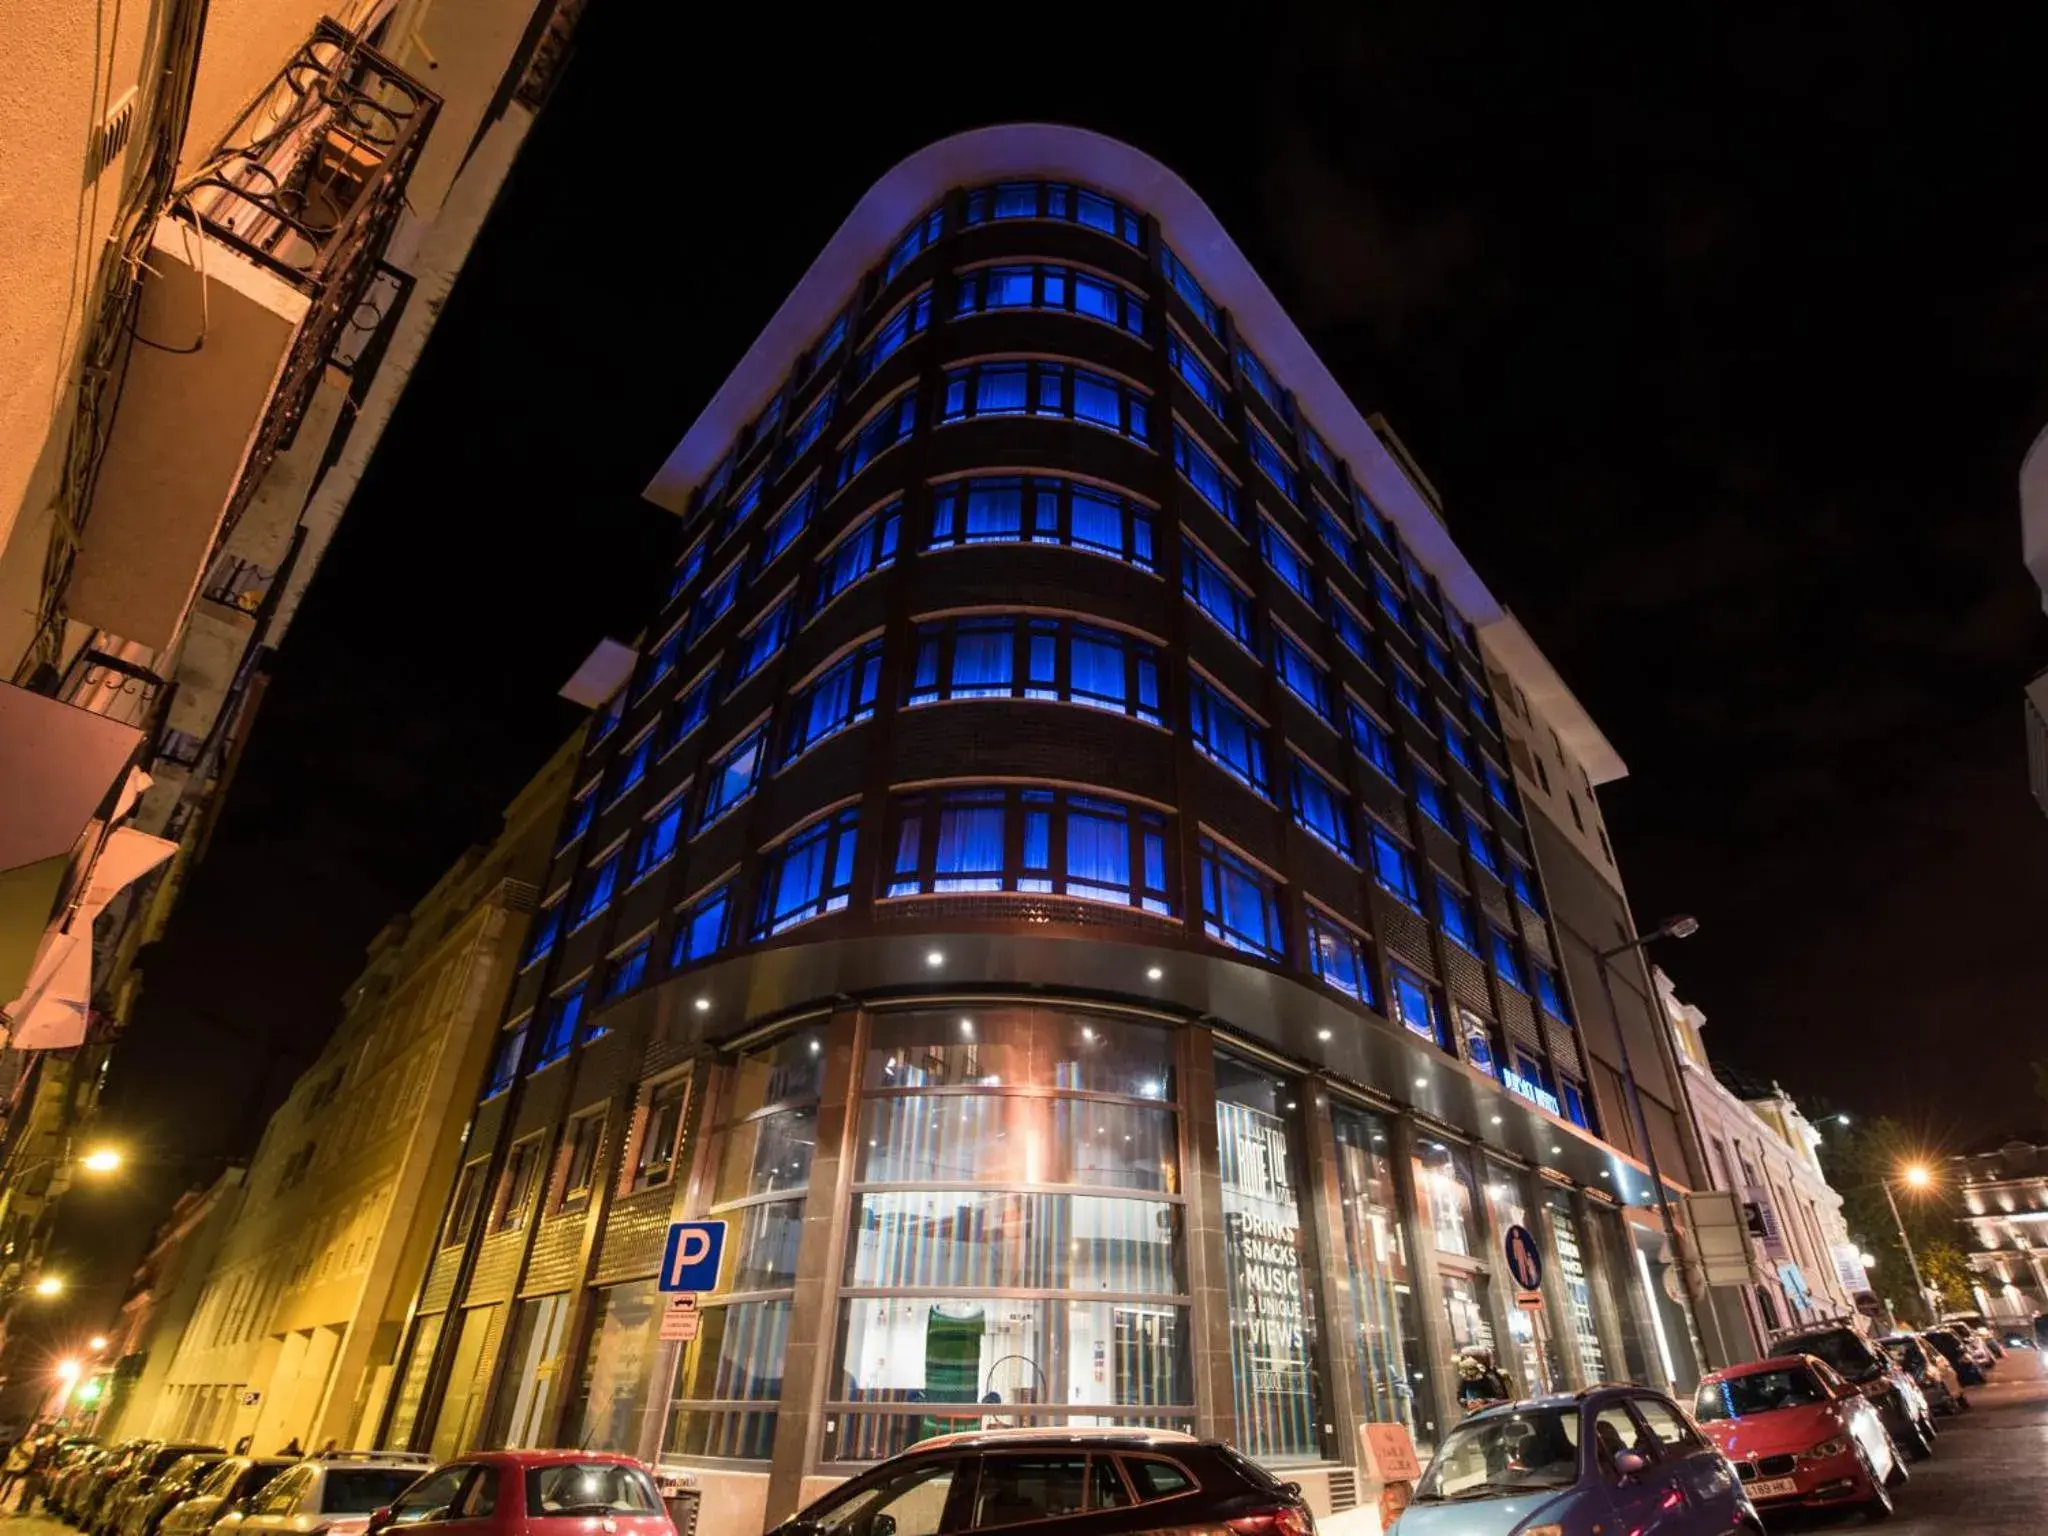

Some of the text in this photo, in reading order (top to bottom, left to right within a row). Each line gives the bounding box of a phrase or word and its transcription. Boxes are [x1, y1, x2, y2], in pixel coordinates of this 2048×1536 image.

[1242, 1210, 1296, 1243] DRINKS
[670, 1229, 711, 1287] P
[1243, 1237, 1297, 1267] SNACKS
[1245, 1263, 1300, 1297] MUSIC
[1247, 1294, 1302, 1320] & UNIQUE
[1248, 1317, 1304, 1349] VIEWS
